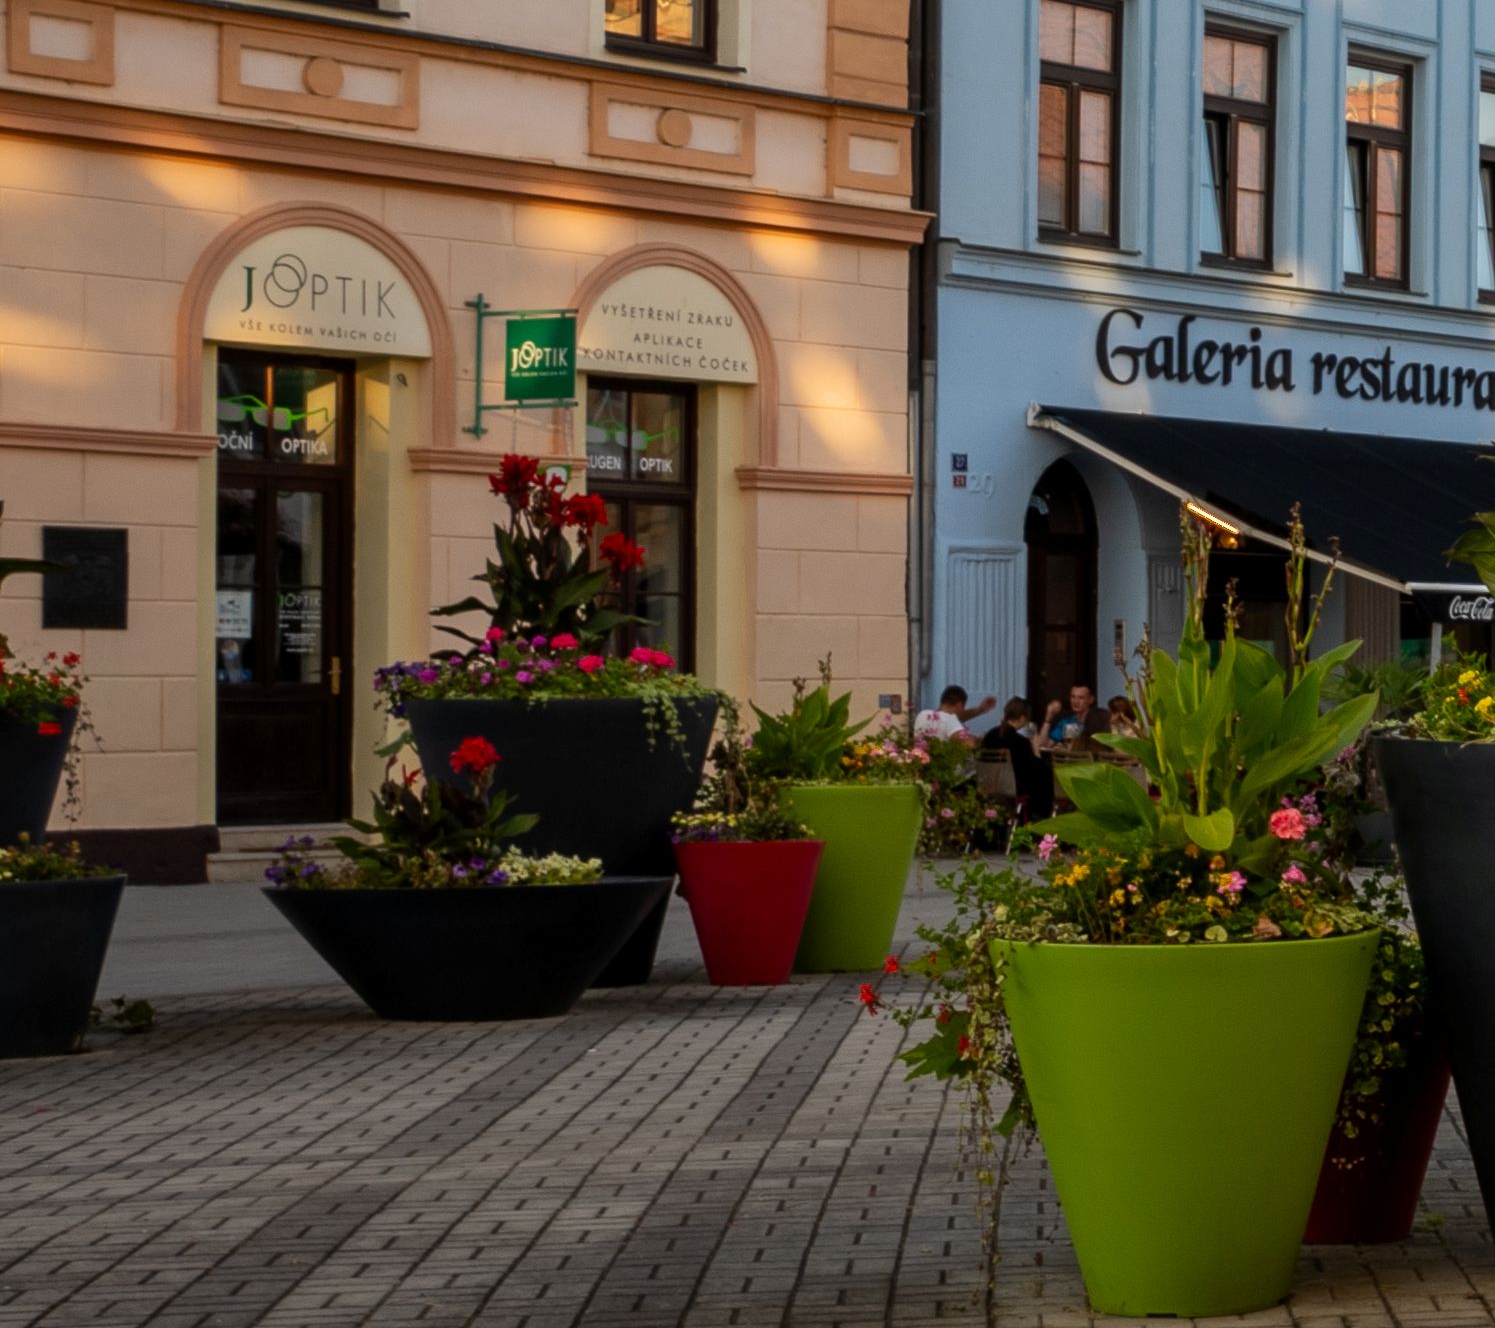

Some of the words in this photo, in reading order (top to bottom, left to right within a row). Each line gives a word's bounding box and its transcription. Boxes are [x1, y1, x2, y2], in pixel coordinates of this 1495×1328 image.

[601, 303, 681, 322] VYŠETŘENÍ
[687, 312, 734, 328] ZRAKU
[239, 318, 263, 332] VŠE
[269, 322, 315, 336] KOLEM
[319, 326, 368, 340] VAŠICH
[373, 330, 397, 343] OČÍ
[633, 333, 704, 350] APLIKACE
[583, 348, 692, 369] KONTAKTNÍCH
[699, 355, 749, 373] ČOČEK
[1095, 308, 1296, 392] Galeria
[217, 431, 254, 451] OČNÍ
[281, 437, 329, 456] OPTIKA
[639, 456, 673, 473] OPTIK
